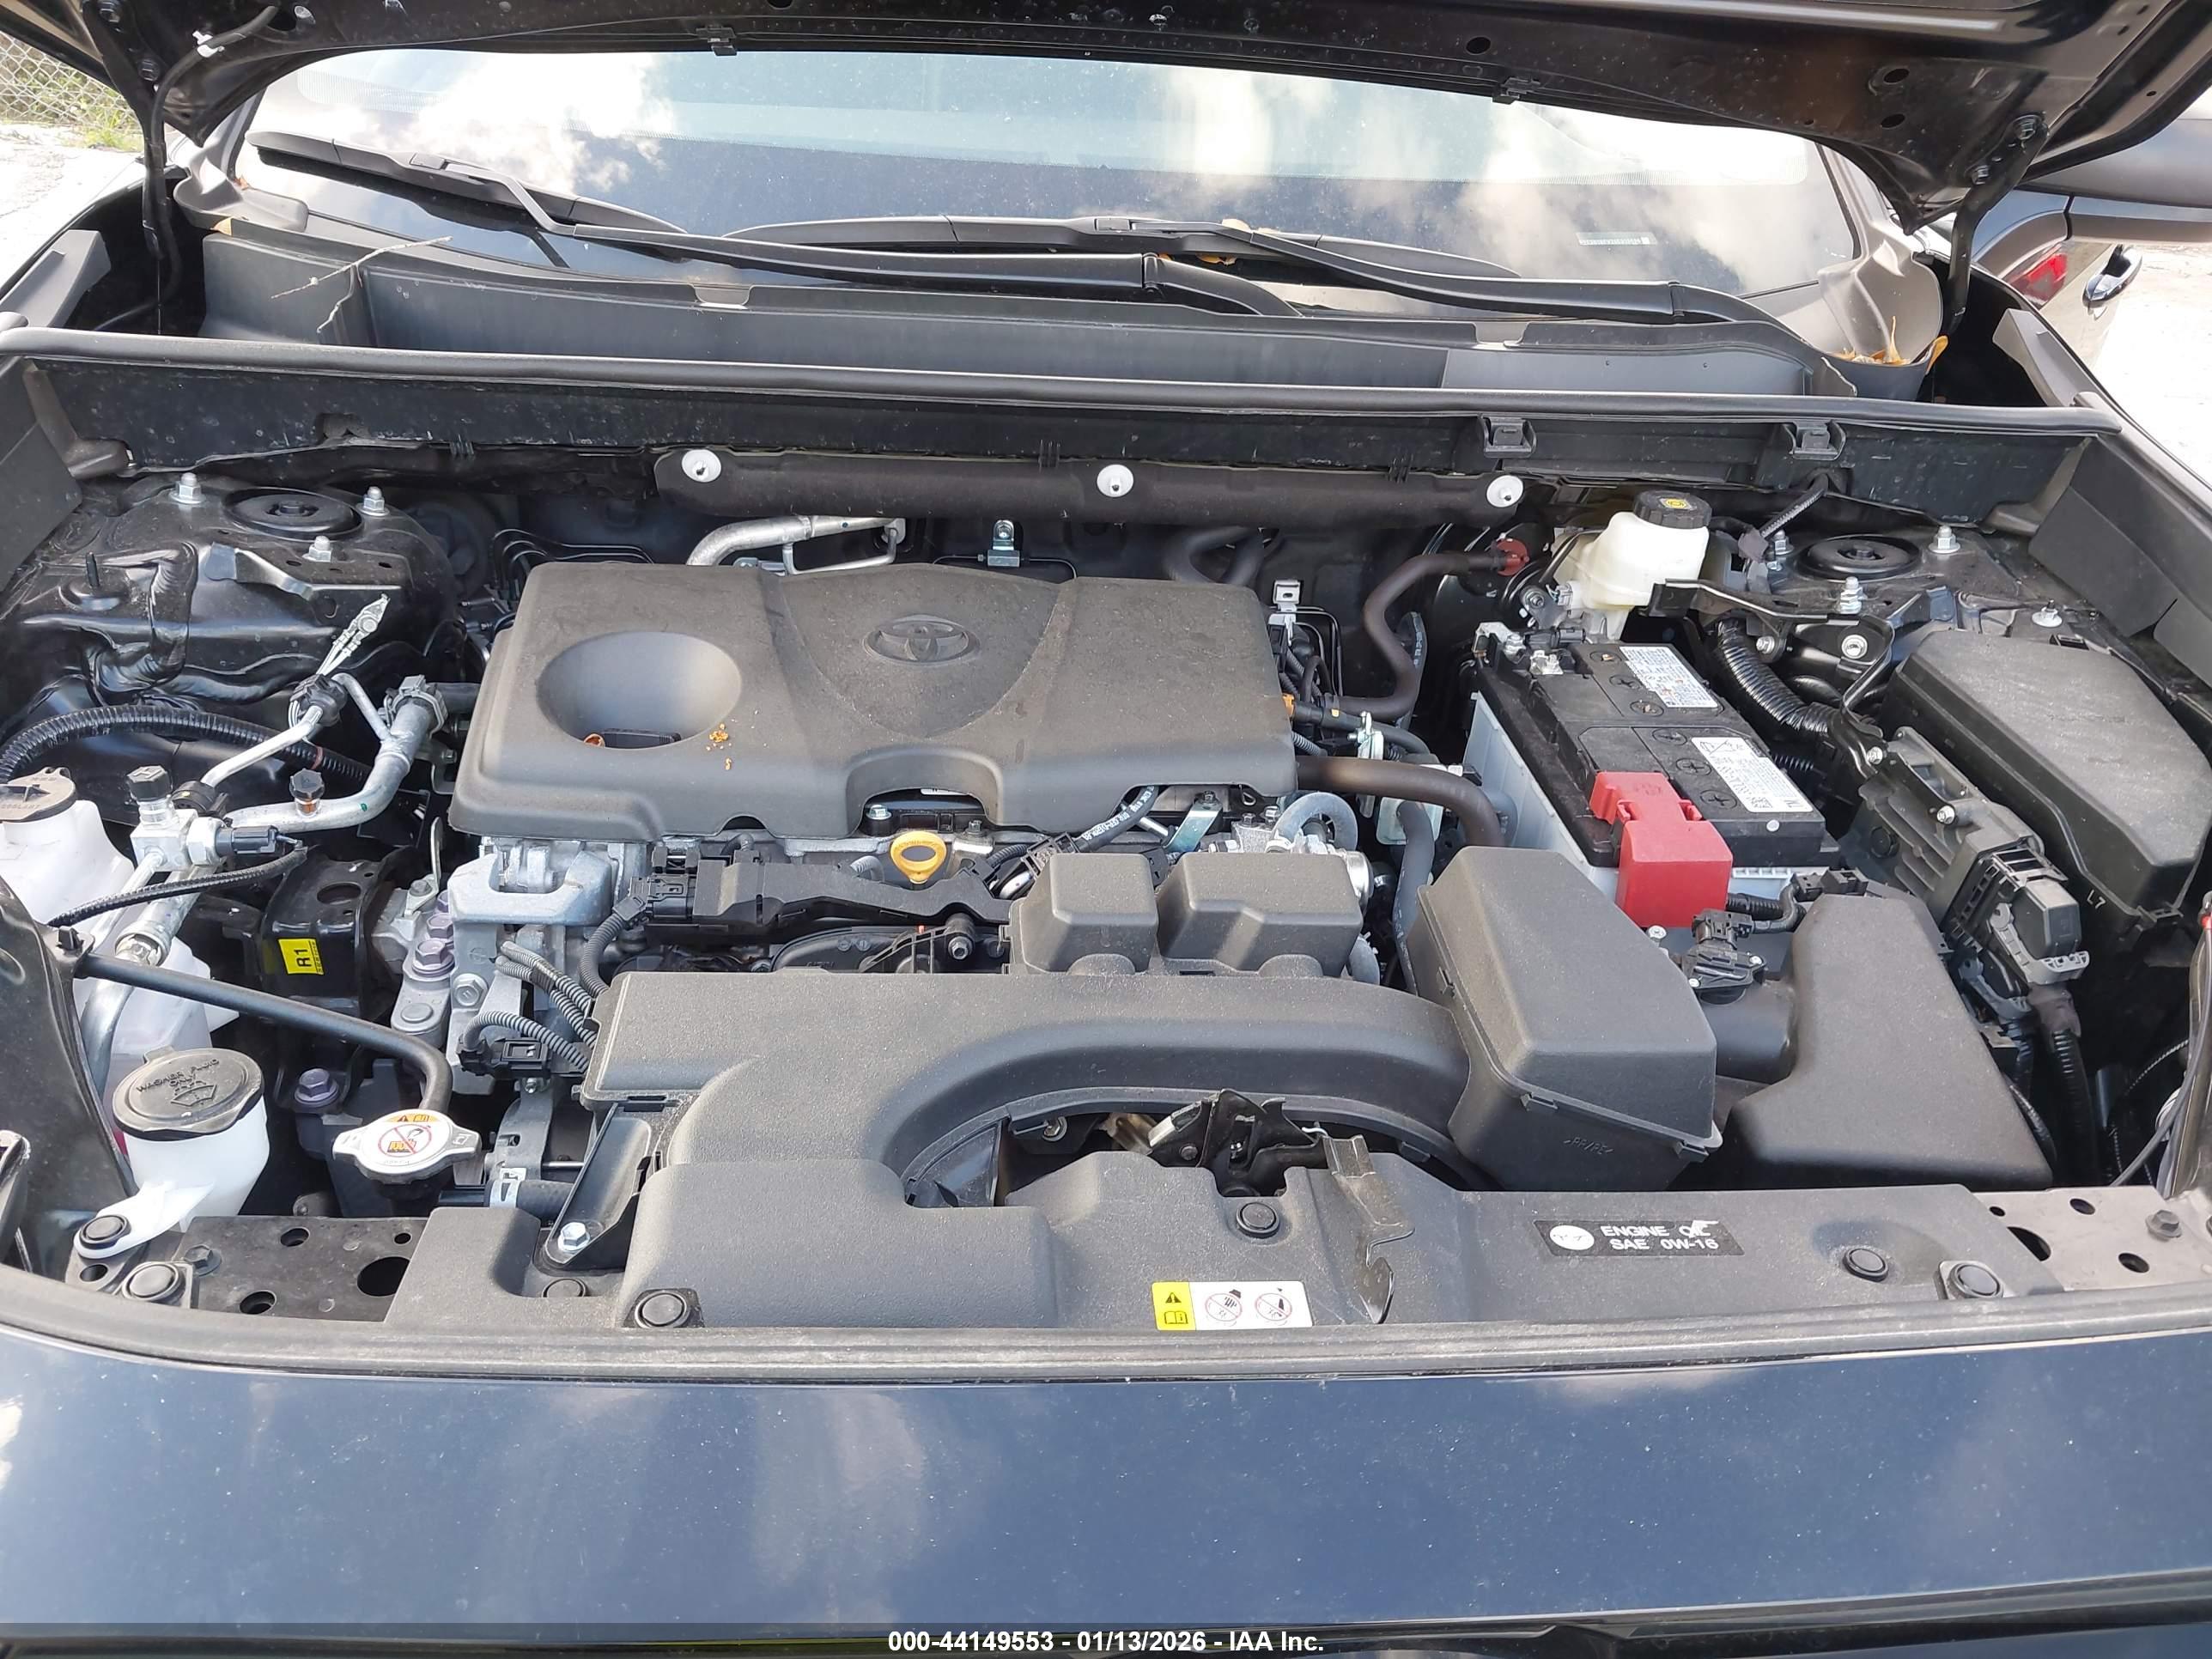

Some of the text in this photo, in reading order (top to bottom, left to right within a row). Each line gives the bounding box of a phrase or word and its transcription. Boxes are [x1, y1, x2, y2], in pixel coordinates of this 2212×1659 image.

[294, 949, 312, 967] R1
[1600, 1224, 1670, 1237] ENGINE
[1609, 1238, 1719, 1250] SAE 0W-16
